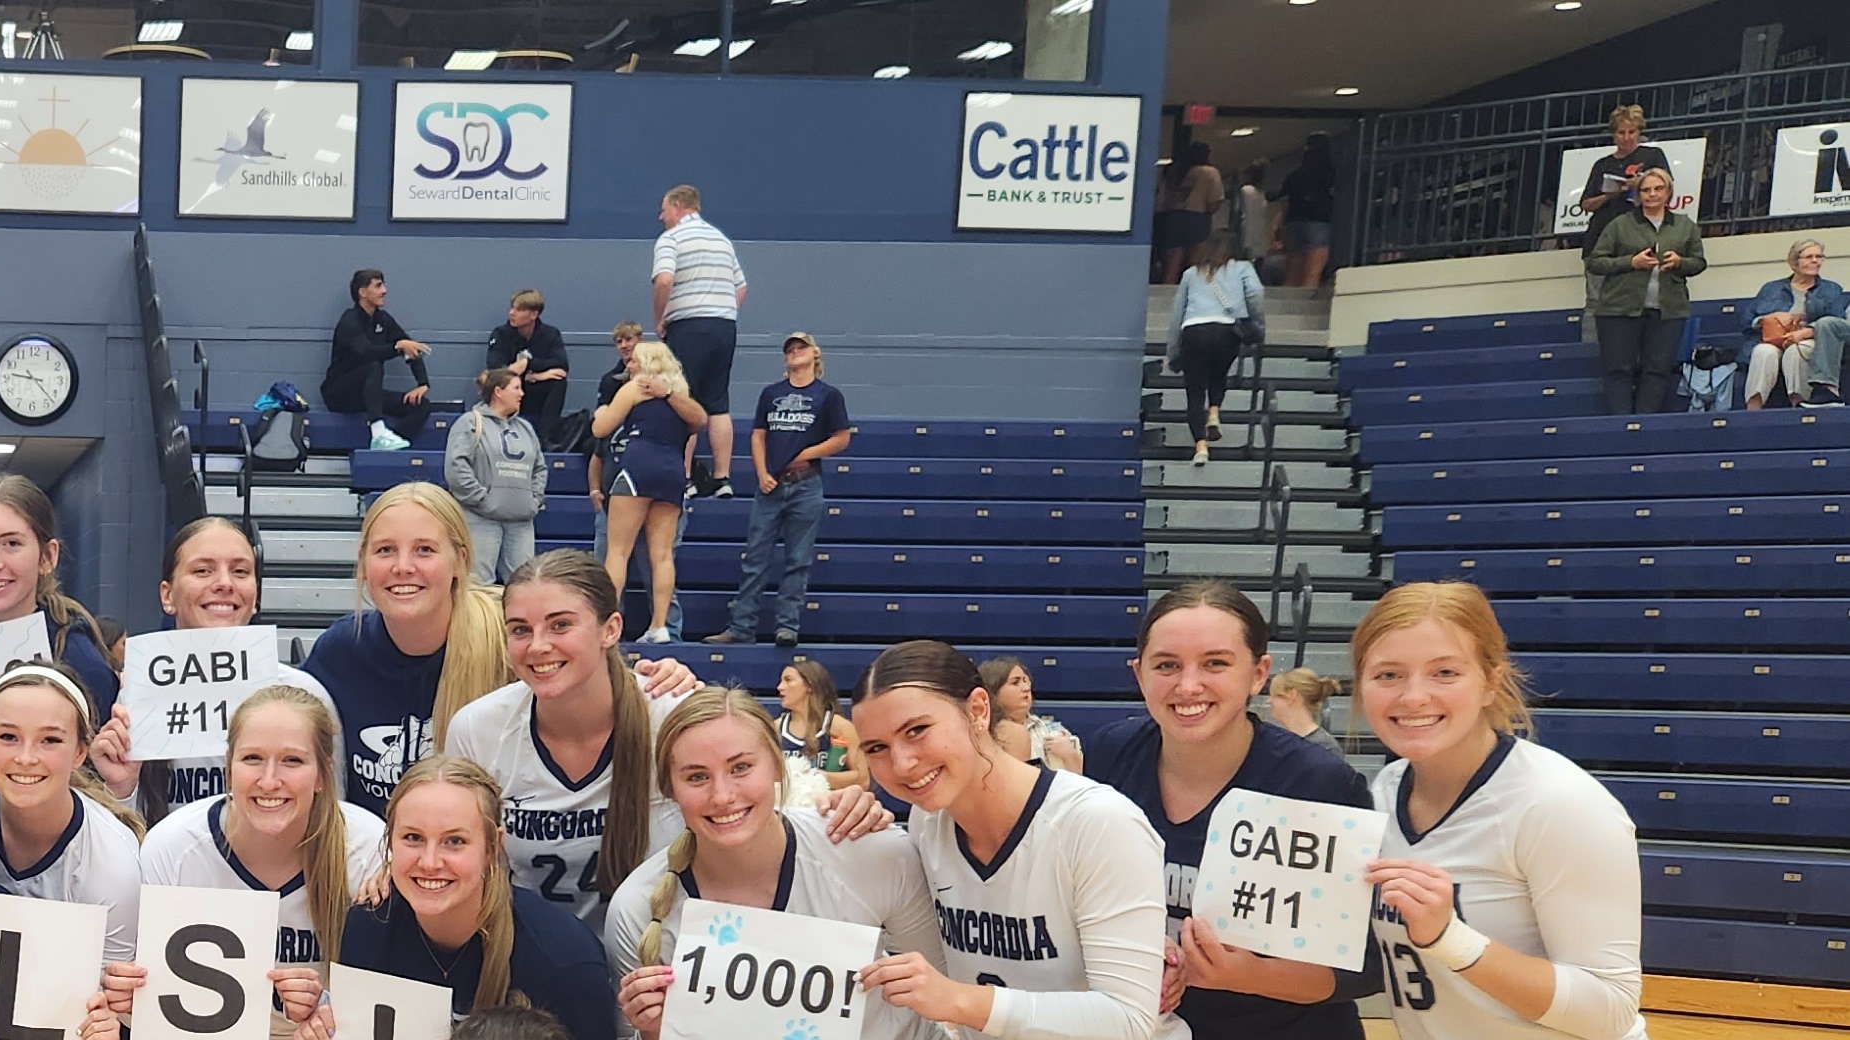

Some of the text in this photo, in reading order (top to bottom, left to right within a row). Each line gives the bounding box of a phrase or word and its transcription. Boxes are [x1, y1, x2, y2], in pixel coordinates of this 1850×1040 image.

[414, 101, 551, 181] SDC
[968, 121, 1130, 183] Cattle
[240, 170, 343, 188] Sandhills Global
[987, 189, 1104, 205] BANK & TRUST
[16, 350, 25, 360] 11
[29, 346, 41, 357] 12
[45, 351, 51, 361] 1
[6, 359, 17, 370] 10
[54, 361, 61, 372] 2
[3, 373, 11, 383] 9
[56, 376, 64, 387] 3
[6, 386, 14, 396] 8
[16, 398, 23, 408] 7
[28, 401, 36, 412] 6
[42, 399, 50, 409] 5
[499, 429, 525, 460] C
[148, 650, 248, 686] GABI
[166, 700, 228, 735] #11
[1230, 820, 1337, 873] GABI
[1233, 881, 1301, 928] #11
[1382, 939, 1435, 1010] 13
[681, 945, 858, 1018] 1,000!
